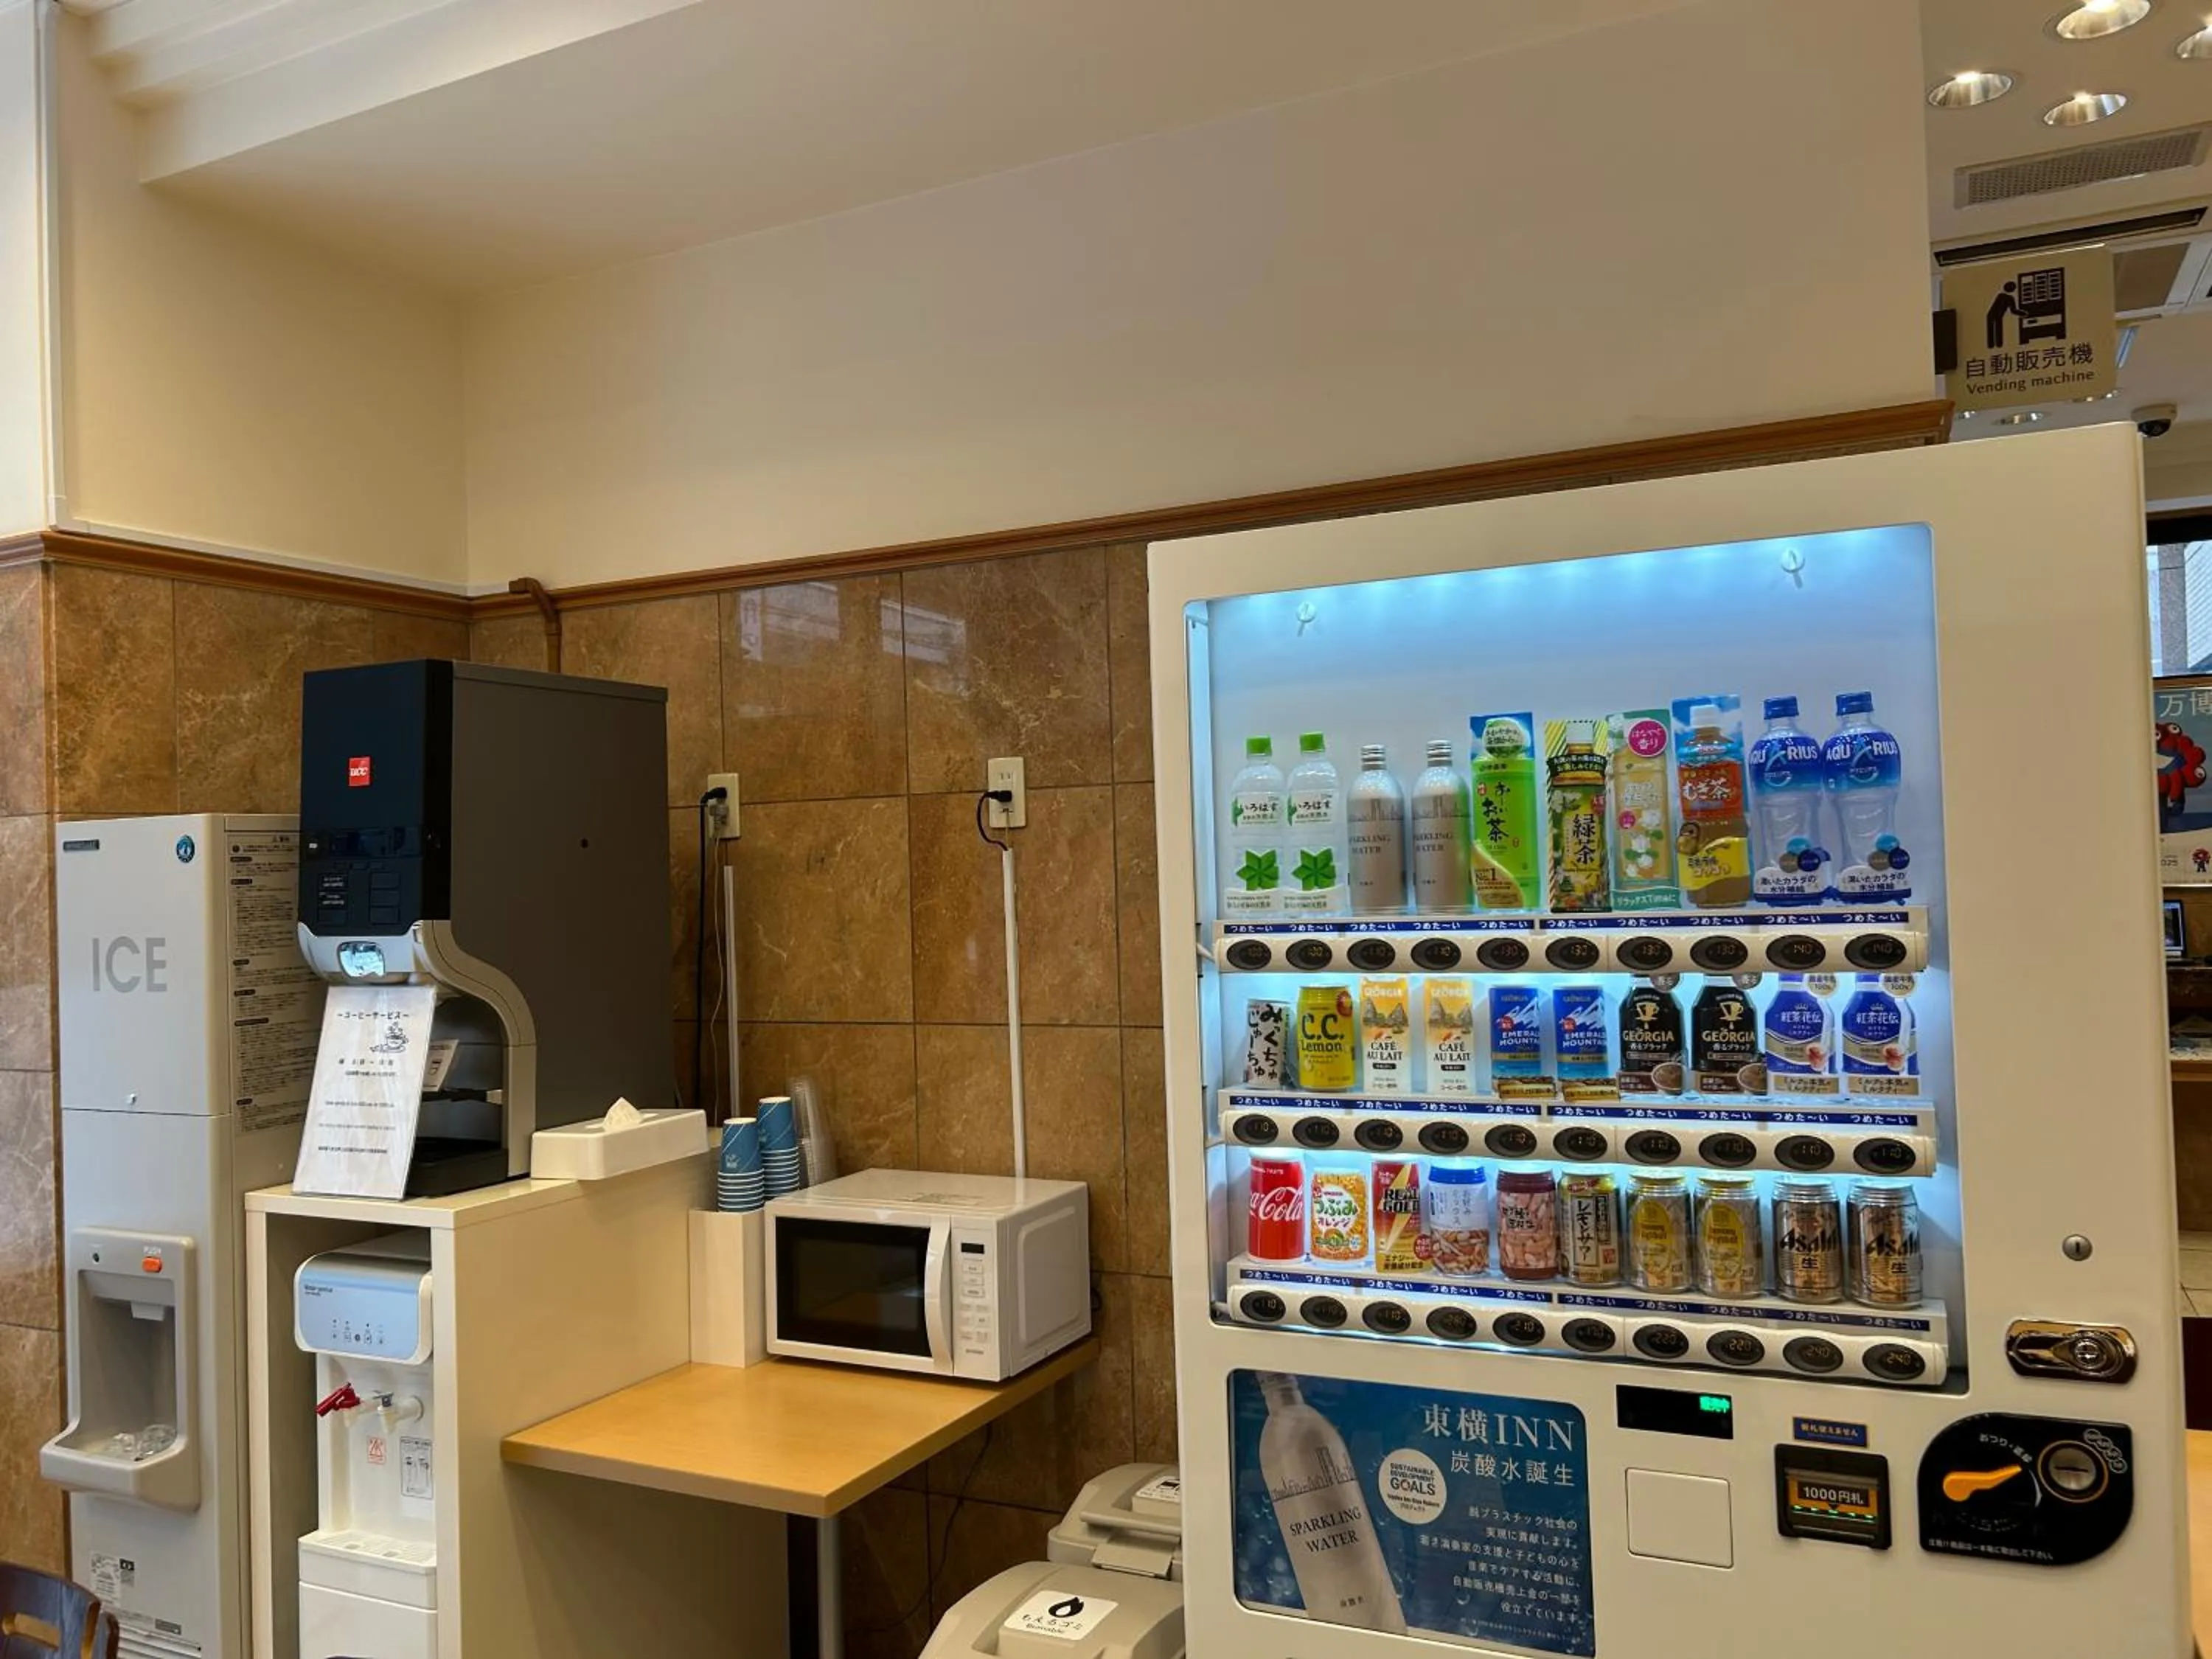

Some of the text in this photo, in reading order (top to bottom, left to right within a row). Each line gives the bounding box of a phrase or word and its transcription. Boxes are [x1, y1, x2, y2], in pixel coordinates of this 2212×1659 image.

[1966, 342, 2095, 379] 自動販売機
[1966, 369, 2095, 395] Vending machine
[1573, 813, 1596, 864] 緑茶
[1717, 945, 1736, 956] 130
[1794, 945, 1812, 954] 140
[1873, 943, 1893, 954] 140
[92, 935, 168, 994] ICE
[1781, 1011, 1822, 1023] 紅茶花伝
[1856, 1012, 1900, 1024] 紅茶花伝
[1301, 1013, 1345, 1040] C.C.
[1623, 1029, 1674, 1041] GEORGIA
[1702, 1029, 1755, 1042] GEORGIA
[1371, 1040, 1397, 1051] CAFÉ
[1439, 1040, 1465, 1051] CAFÉ
[1380, 1051, 1403, 1061] LAIT
[1449, 1052, 1471, 1062] LAIT
[1576, 1200, 1593, 1261] レモンサワー
[1779, 1228, 1837, 1252] Asahi
[1801, 1257, 1818, 1269] 生
[1891, 1262, 1907, 1273] 生
[1729, 1339, 1752, 1351] 220
[1806, 1345, 1829, 1357] 240
[1886, 1352, 1911, 1365] 240
[1423, 1403, 1574, 1452] 東横INN
[1450, 1450, 1575, 1487] 炭酸水誕生
[1391, 1477, 1435, 1495] GOALS
[1804, 1486, 1864, 1505] 1000円札
[1290, 1506, 1362, 1537] SPARKLING
[1306, 1529, 1359, 1553] WATER
